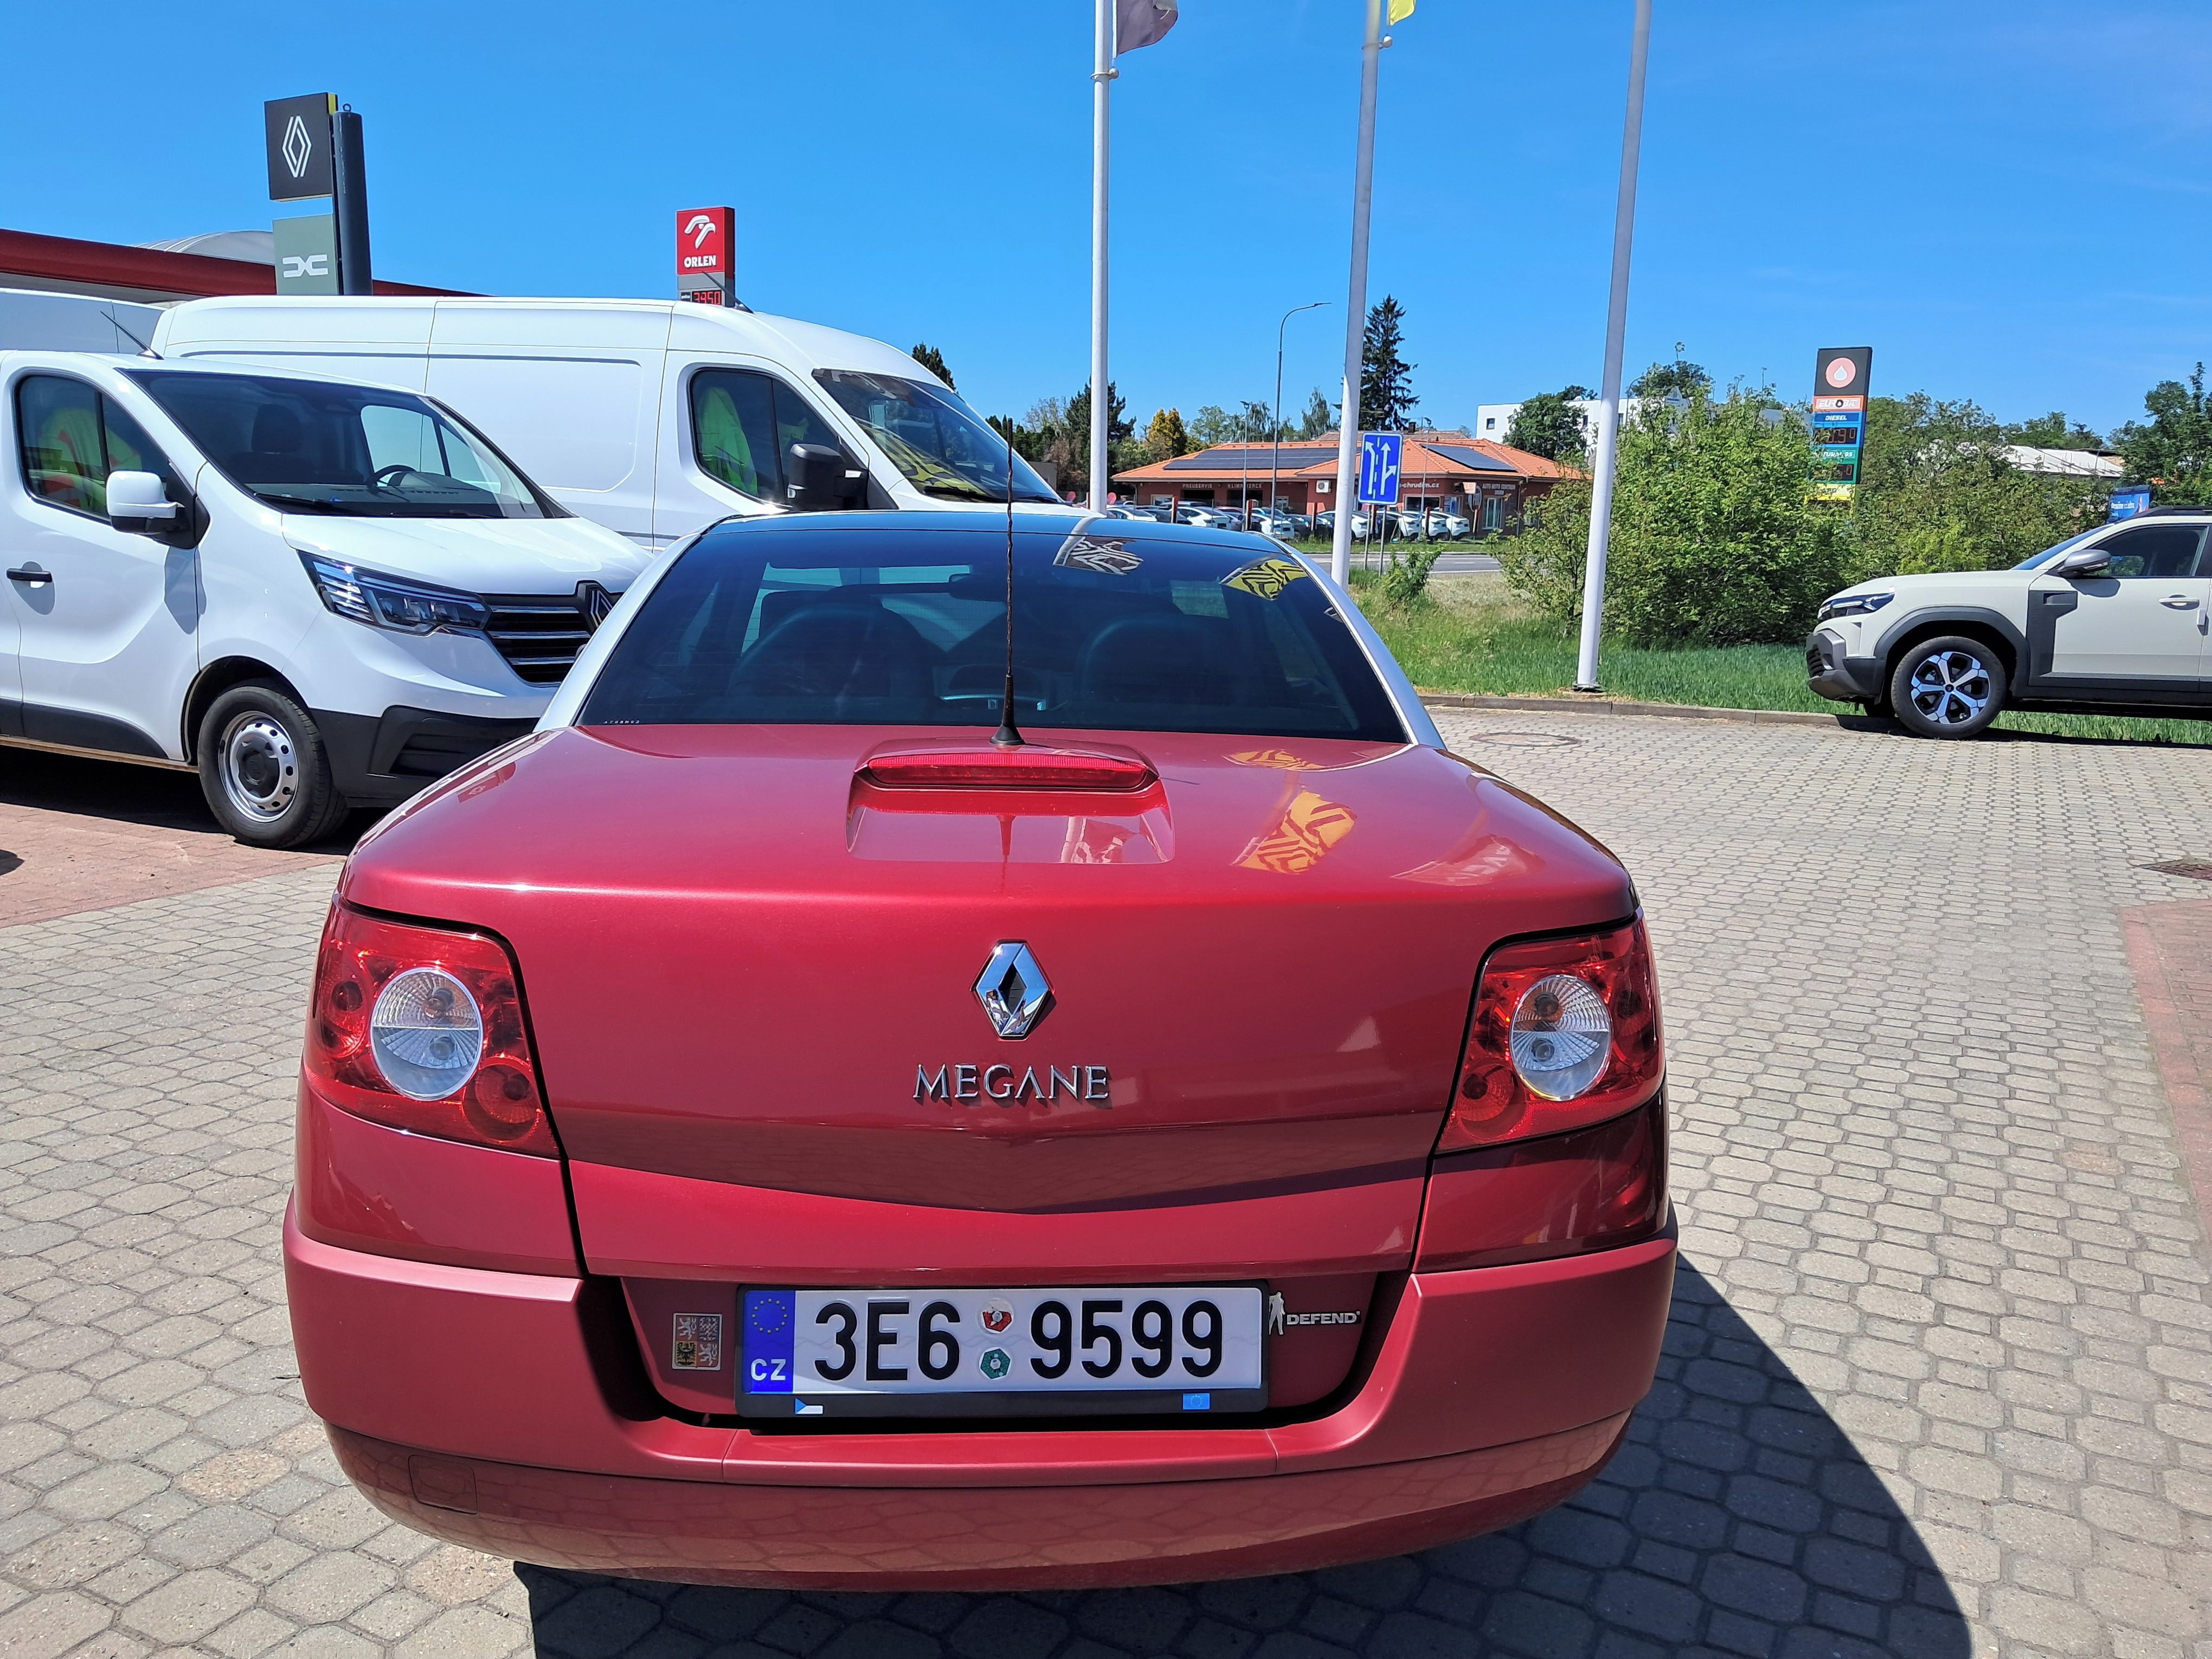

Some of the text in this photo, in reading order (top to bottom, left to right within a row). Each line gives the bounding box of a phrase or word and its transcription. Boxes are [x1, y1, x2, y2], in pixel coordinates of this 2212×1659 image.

[684, 255, 716, 268] ORLEN
[912, 1063, 1108, 1099] MEGANE
[814, 1300, 1223, 1381] 3E6 9599
[750, 1358, 786, 1381] CZ
